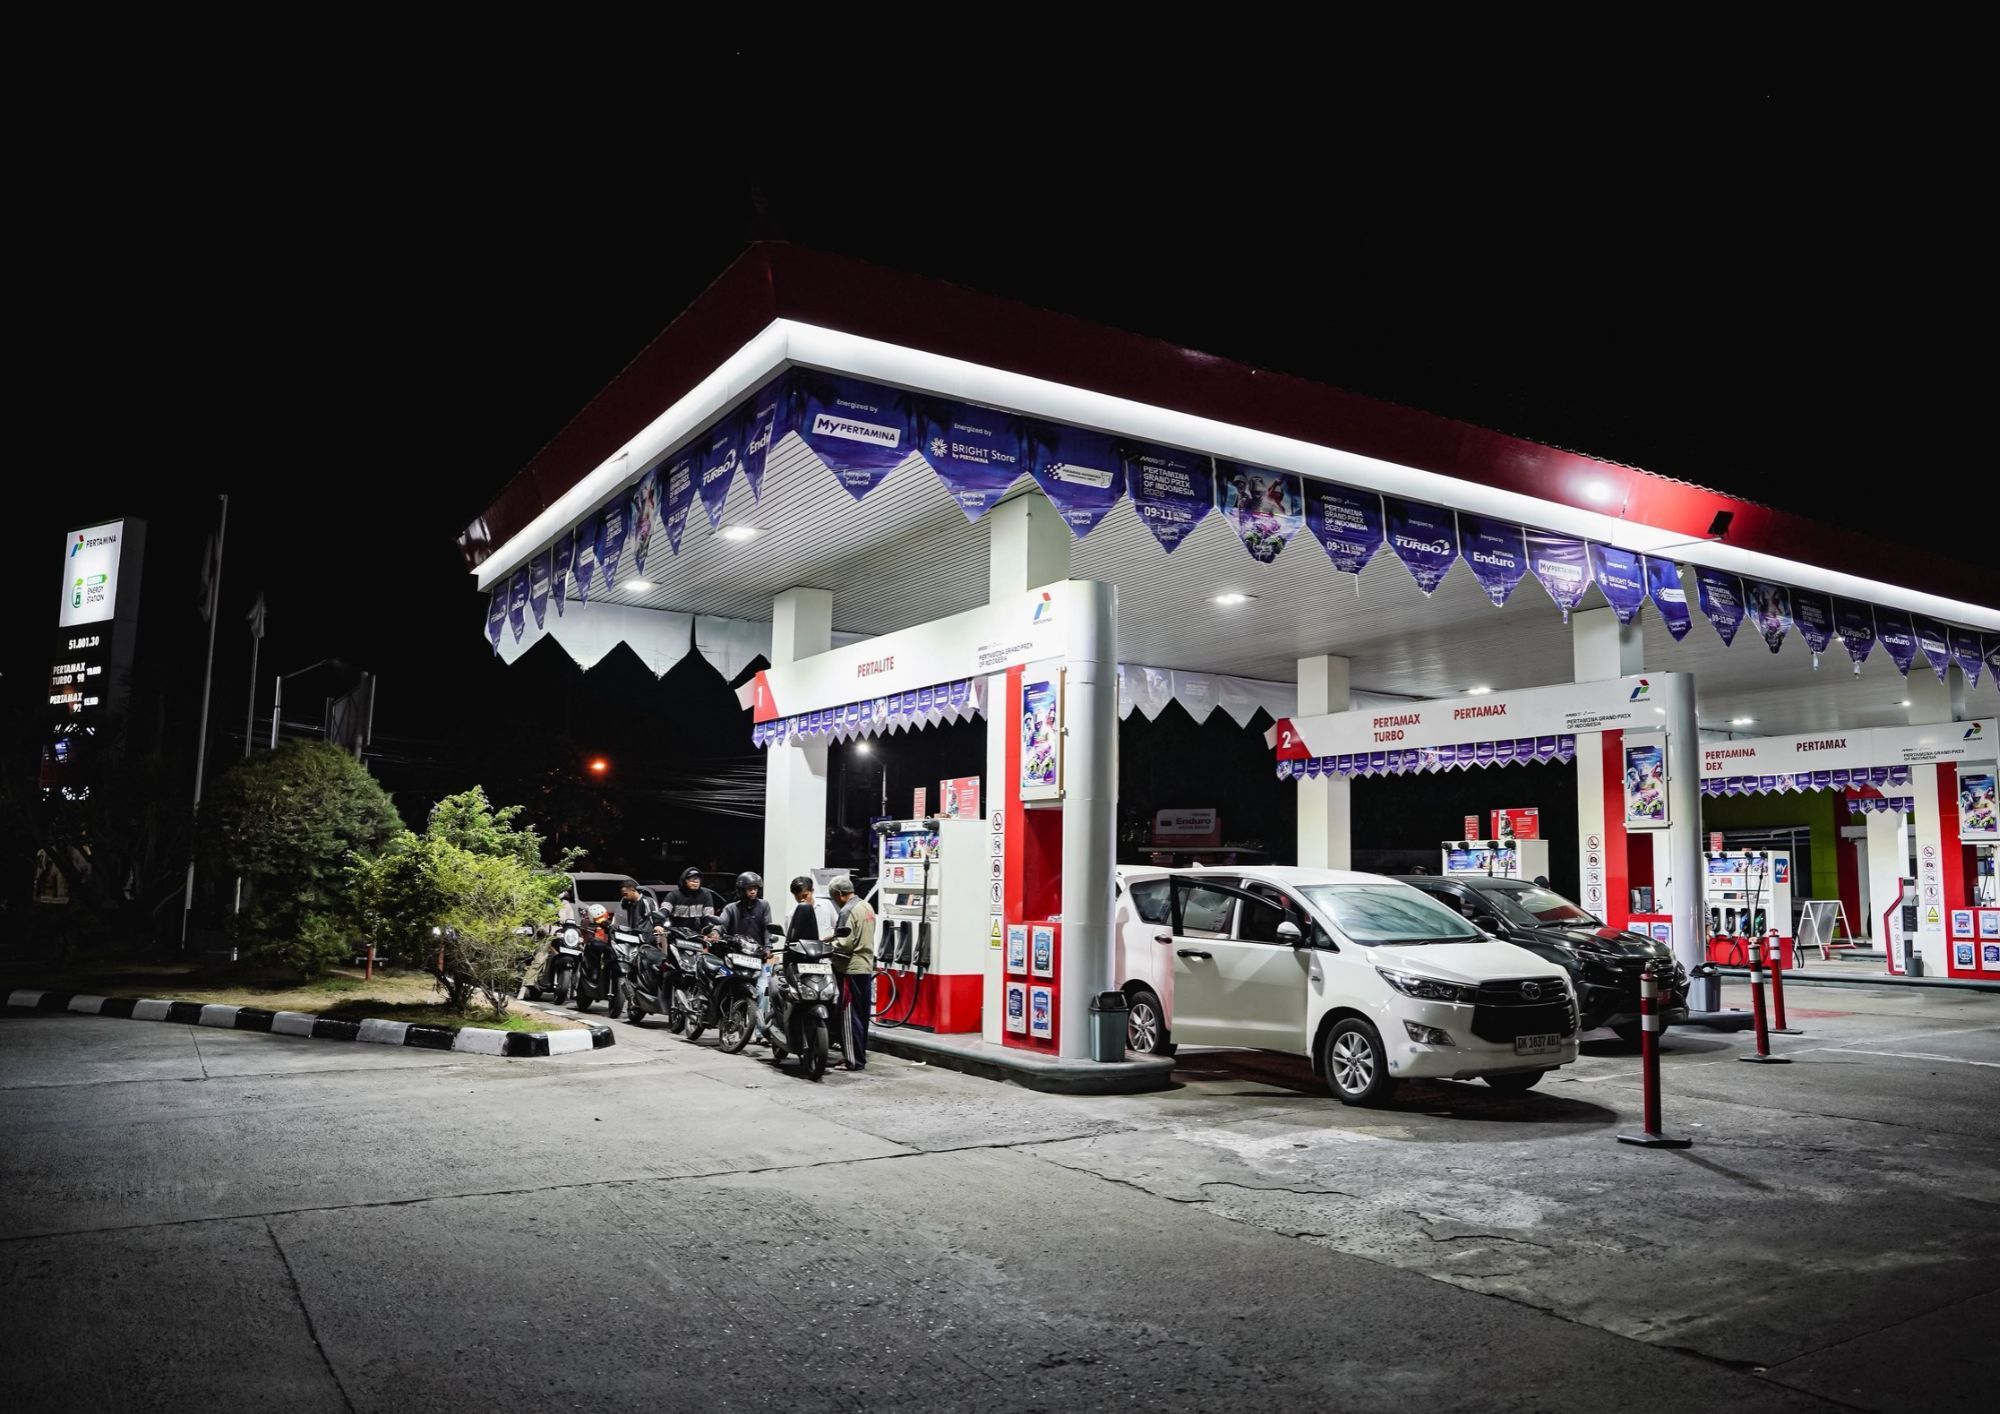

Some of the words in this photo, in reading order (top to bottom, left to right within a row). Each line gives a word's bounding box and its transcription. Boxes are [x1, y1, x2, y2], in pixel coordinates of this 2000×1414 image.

[836, 398, 869, 411] Energized
[869, 404, 879, 414] by
[817, 418, 896, 442] MyPERTAMINA
[953, 423, 983, 434] Energized
[984, 429, 992, 437] by
[951, 442, 989, 458] BRIGHT
[991, 449, 1016, 463] Store
[959, 453, 989, 464] PERTAMINA
[702, 461, 730, 487] TURBO
[1143, 465, 1190, 482] PERTAMINA
[1143, 473, 1170, 484] GRAND
[1171, 478, 1191, 488] PRIX
[1143, 480, 1154, 488] OF
[1155, 482, 1195, 497] INDONESIA
[1144, 506, 1173, 520] 09-11
[1324, 503, 1363, 517] PERTAMINA
[1324, 510, 1347, 520] GRAND
[1347, 515, 1365, 524] PRIX
[1334, 519, 1368, 532] INDONESIA
[86, 535, 117, 549] PERTAMINA
[1326, 541, 1350, 554] 09-11
[1395, 538, 1442, 554] TURBO
[1473, 551, 1515, 568] Enduro
[1884, 635, 1910, 646] Enduro
[53, 662, 86, 675] PERTAMAX
[857, 656, 895, 678] PERTALITE
[52, 674, 73, 685] TURBO
[49, 692, 83, 705] PERTAMAX
[757, 685, 763, 708] 1
[73, 703, 82, 713] 92
[1453, 703, 1507, 720] PERTAMAX
[1373, 714, 1421, 729] PERTAMAX
[1566, 717, 1598, 725] PERTAMINA
[1282, 731, 1292, 749] 2
[1374, 730, 1405, 743] TURBO
[1796, 738, 1847, 752] PERTAMAX
[1705, 747, 1756, 760] PERTAMINA
[1705, 761, 1723, 771] DEX
[1175, 817, 1212, 825] Enduro
